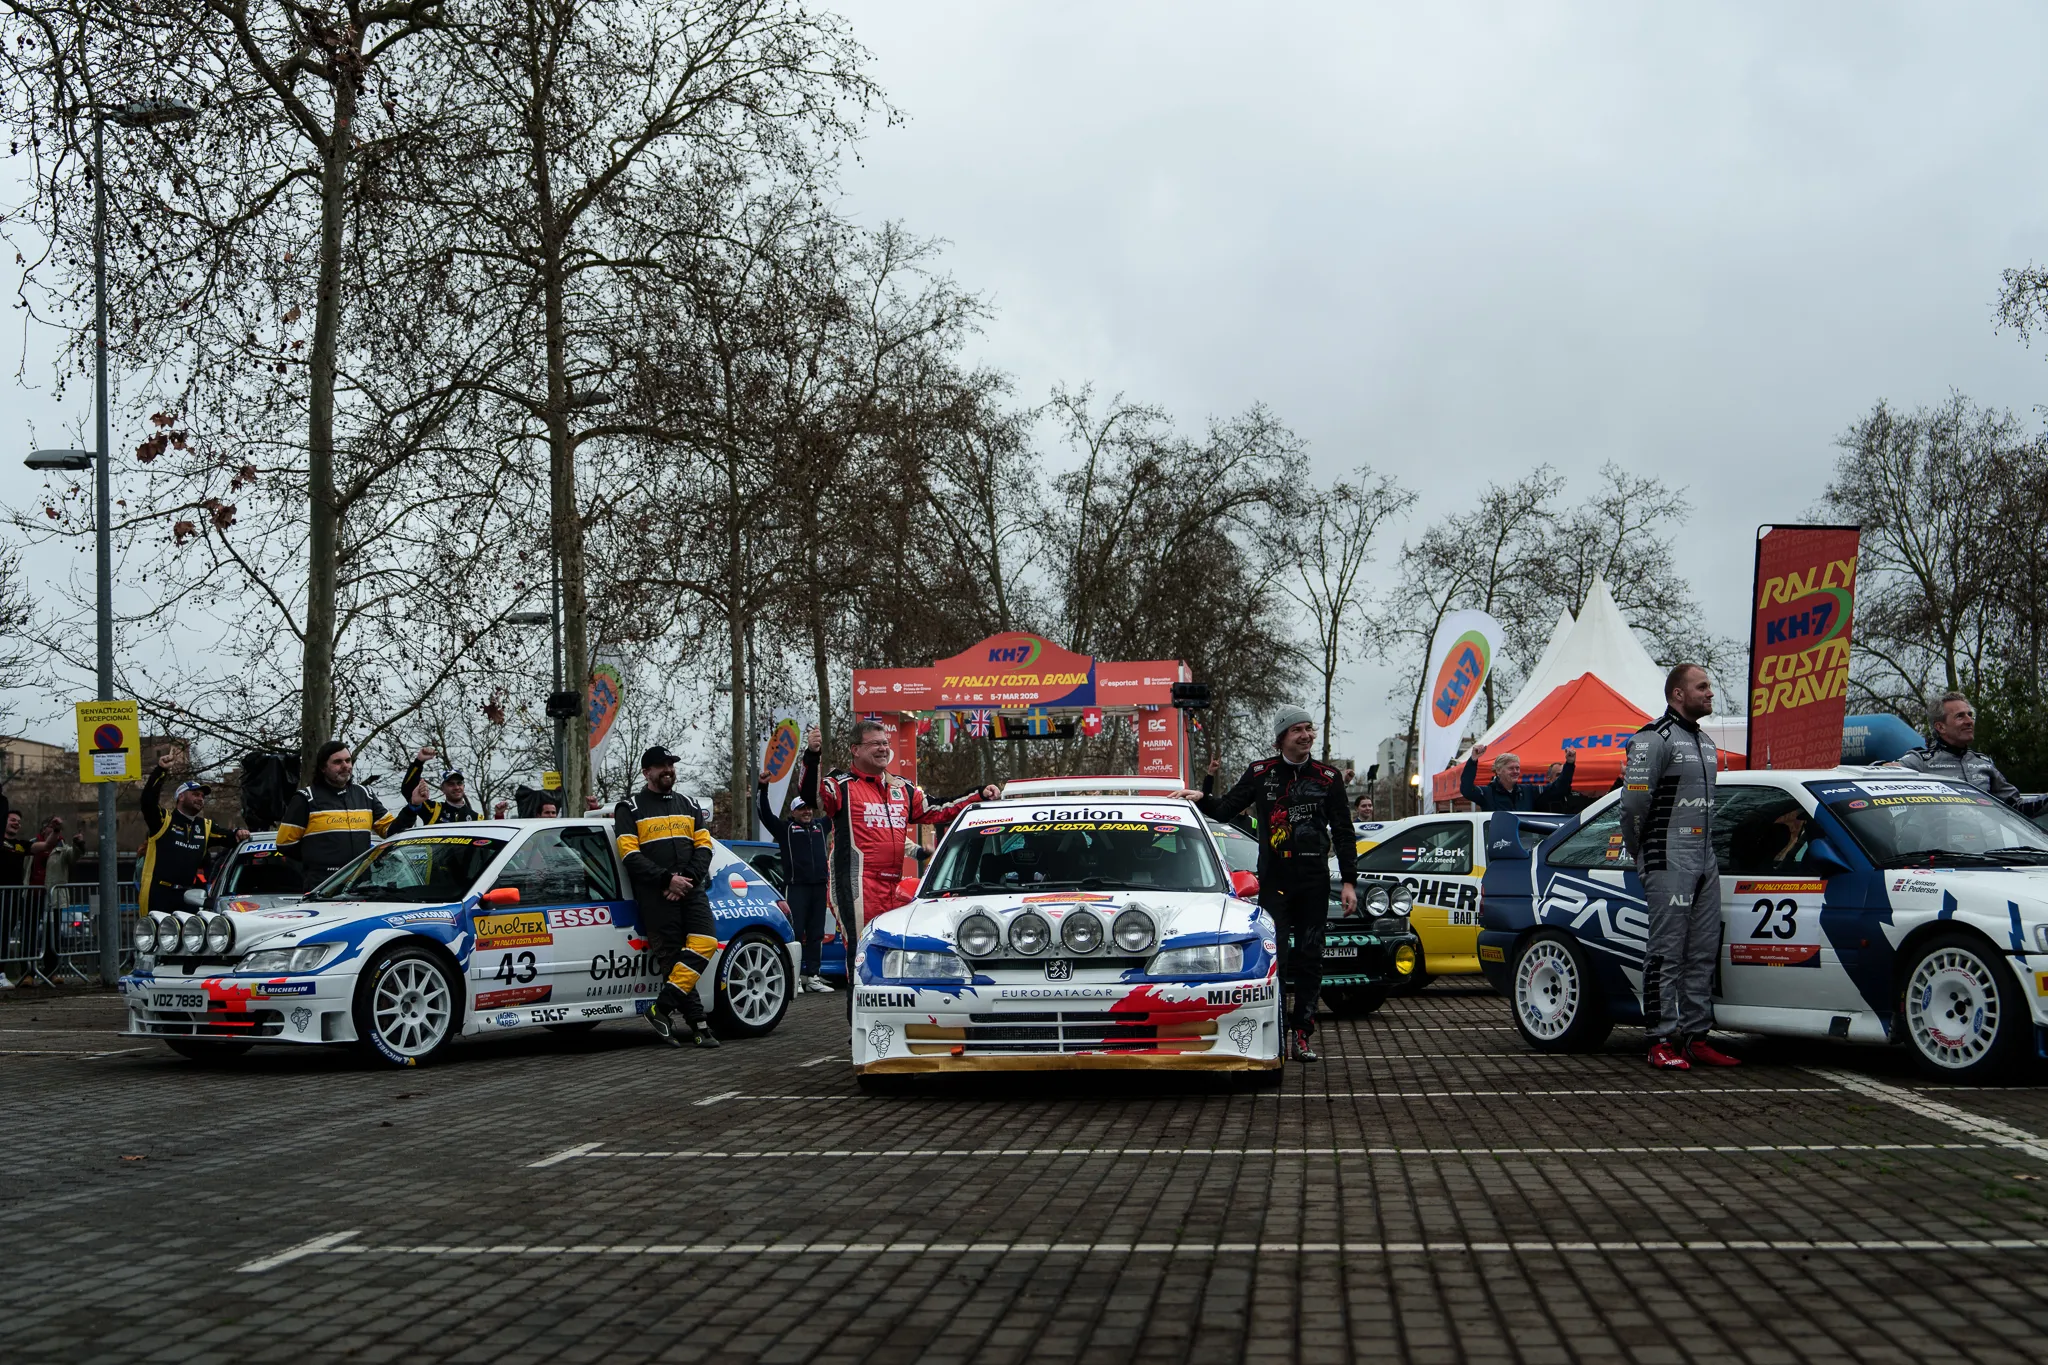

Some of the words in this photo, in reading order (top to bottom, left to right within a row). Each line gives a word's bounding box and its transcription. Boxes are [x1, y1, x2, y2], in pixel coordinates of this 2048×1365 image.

[1759, 556, 1857, 609] RALLY
[1758, 637, 1850, 685] COSTA
[942, 675, 959, 688] 74
[959, 675, 999, 687] RALLY
[1000, 674, 1040, 686] COSTA
[1042, 673, 1088, 685] BRAVA
[1108, 679, 1138, 687] esportcat
[1020, 692, 1039, 700] 2026
[1751, 667, 1848, 717] BRAVA
[80, 706, 133, 714] SENYALITZACIÓ
[1143, 739, 1173, 748] MARINA
[1867, 784, 1933, 793] M-SPORT
[1873, 797, 1906, 807] RALLY
[1032, 808, 1123, 821] clarion
[1008, 824, 1053, 833] RALLY
[1053, 823, 1096, 831] COSTA
[1098, 823, 1149, 832] BRAVA
[1417, 848, 1429, 856] P.
[1435, 848, 1465, 857] Berk
[709, 899, 764, 910] RESEAU
[402, 911, 452, 920] AUTOCOLOR
[548, 908, 611, 927] ESSO
[712, 906, 769, 920] PEUGEOT
[1454, 911, 1472, 924] BAD
[1750, 898, 1798, 939] 23
[1338, 948, 1355, 956] HWL
[493, 951, 538, 985] 43
[586, 986, 603, 996] CAR
[606, 984, 632, 995] AUDIO
[1001, 988, 1113, 998] EURODATACAR
[1207, 985, 1274, 1004] MICHELIN
[152, 994, 174, 1007] VDZ
[176, 994, 203, 1008] 7833
[531, 1008, 569, 1023] SKF
[581, 1004, 623, 1017] speedline
